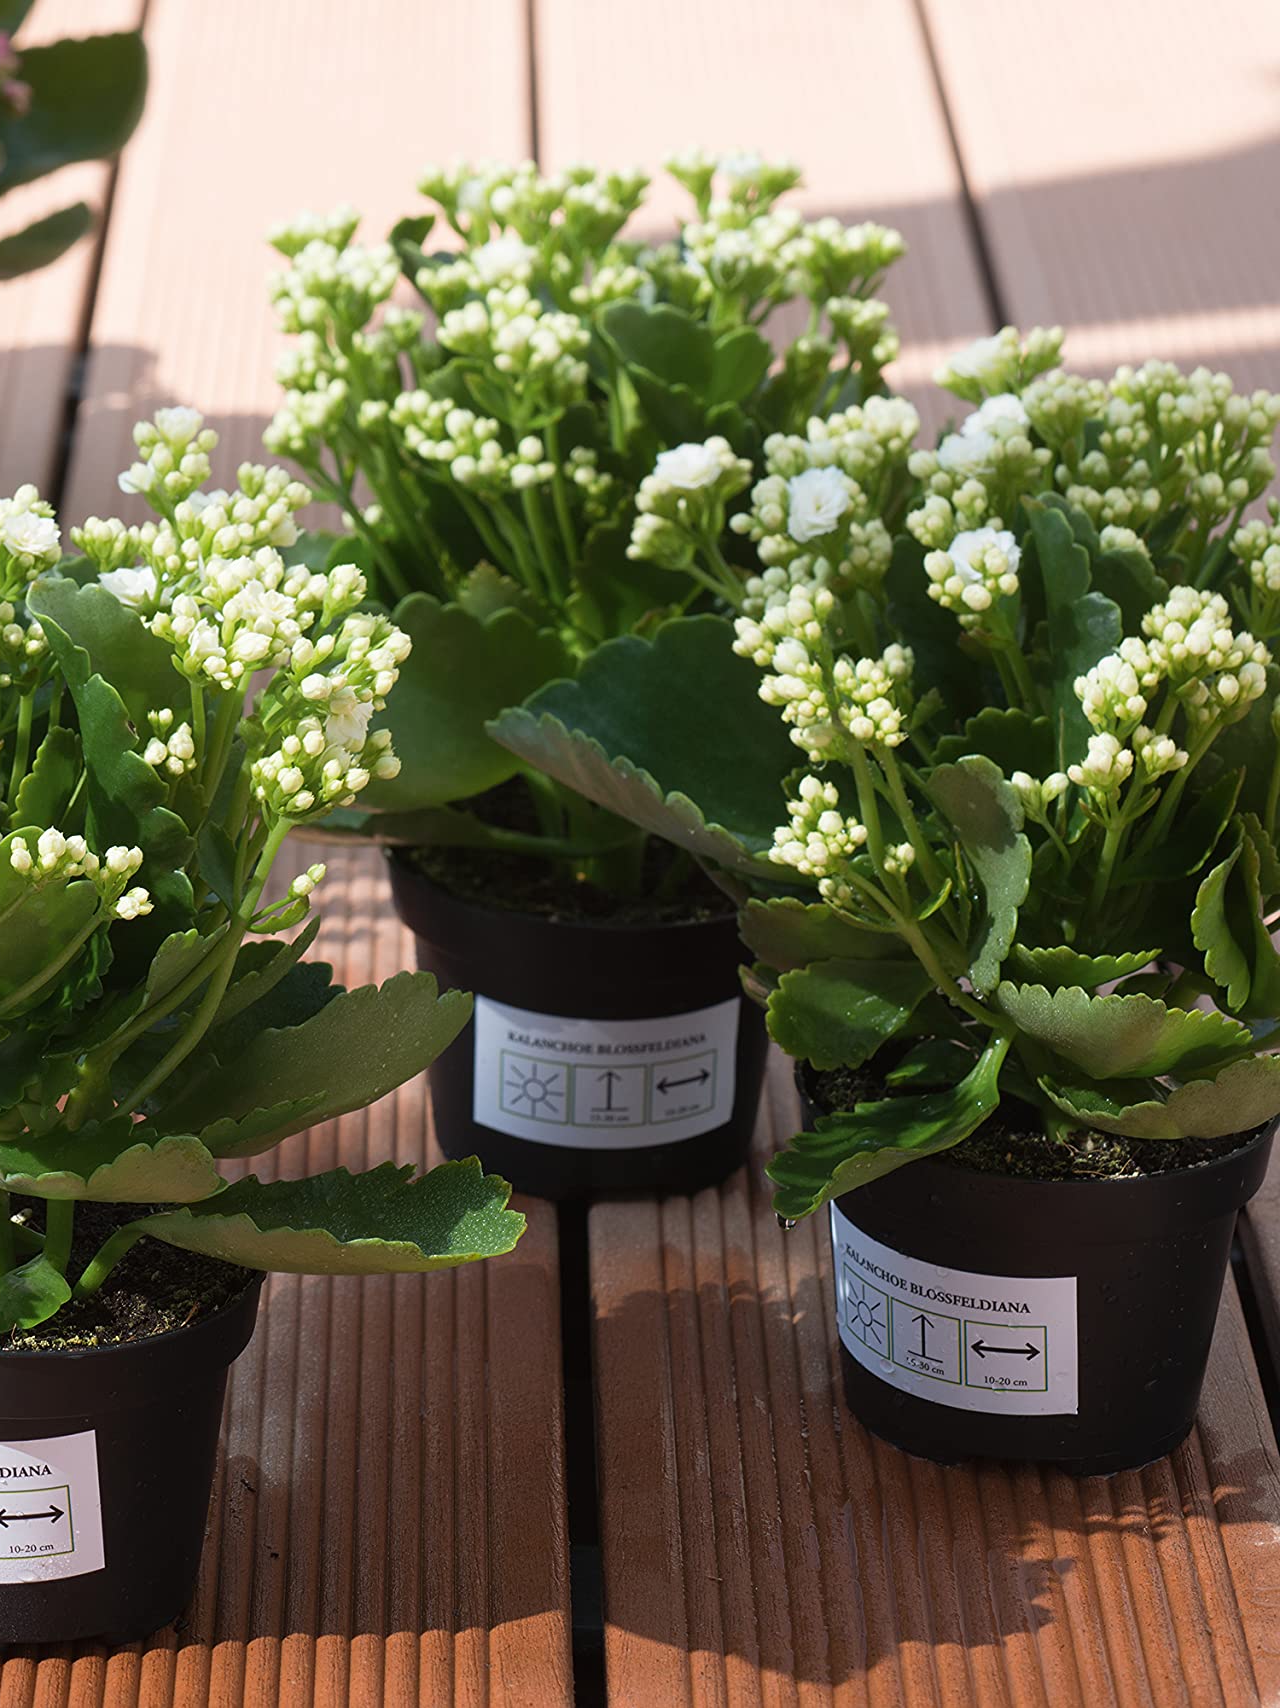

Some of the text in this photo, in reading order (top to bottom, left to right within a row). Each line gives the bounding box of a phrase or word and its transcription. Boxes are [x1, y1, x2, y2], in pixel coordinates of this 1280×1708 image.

[846, 1243, 1031, 1315] KALANCHOE BLOSSFELDIANA
[931, 1367, 945, 1376] cm
[983, 1375, 1011, 1386] 10-20
[9, 1545, 36, 1554] 10-20
